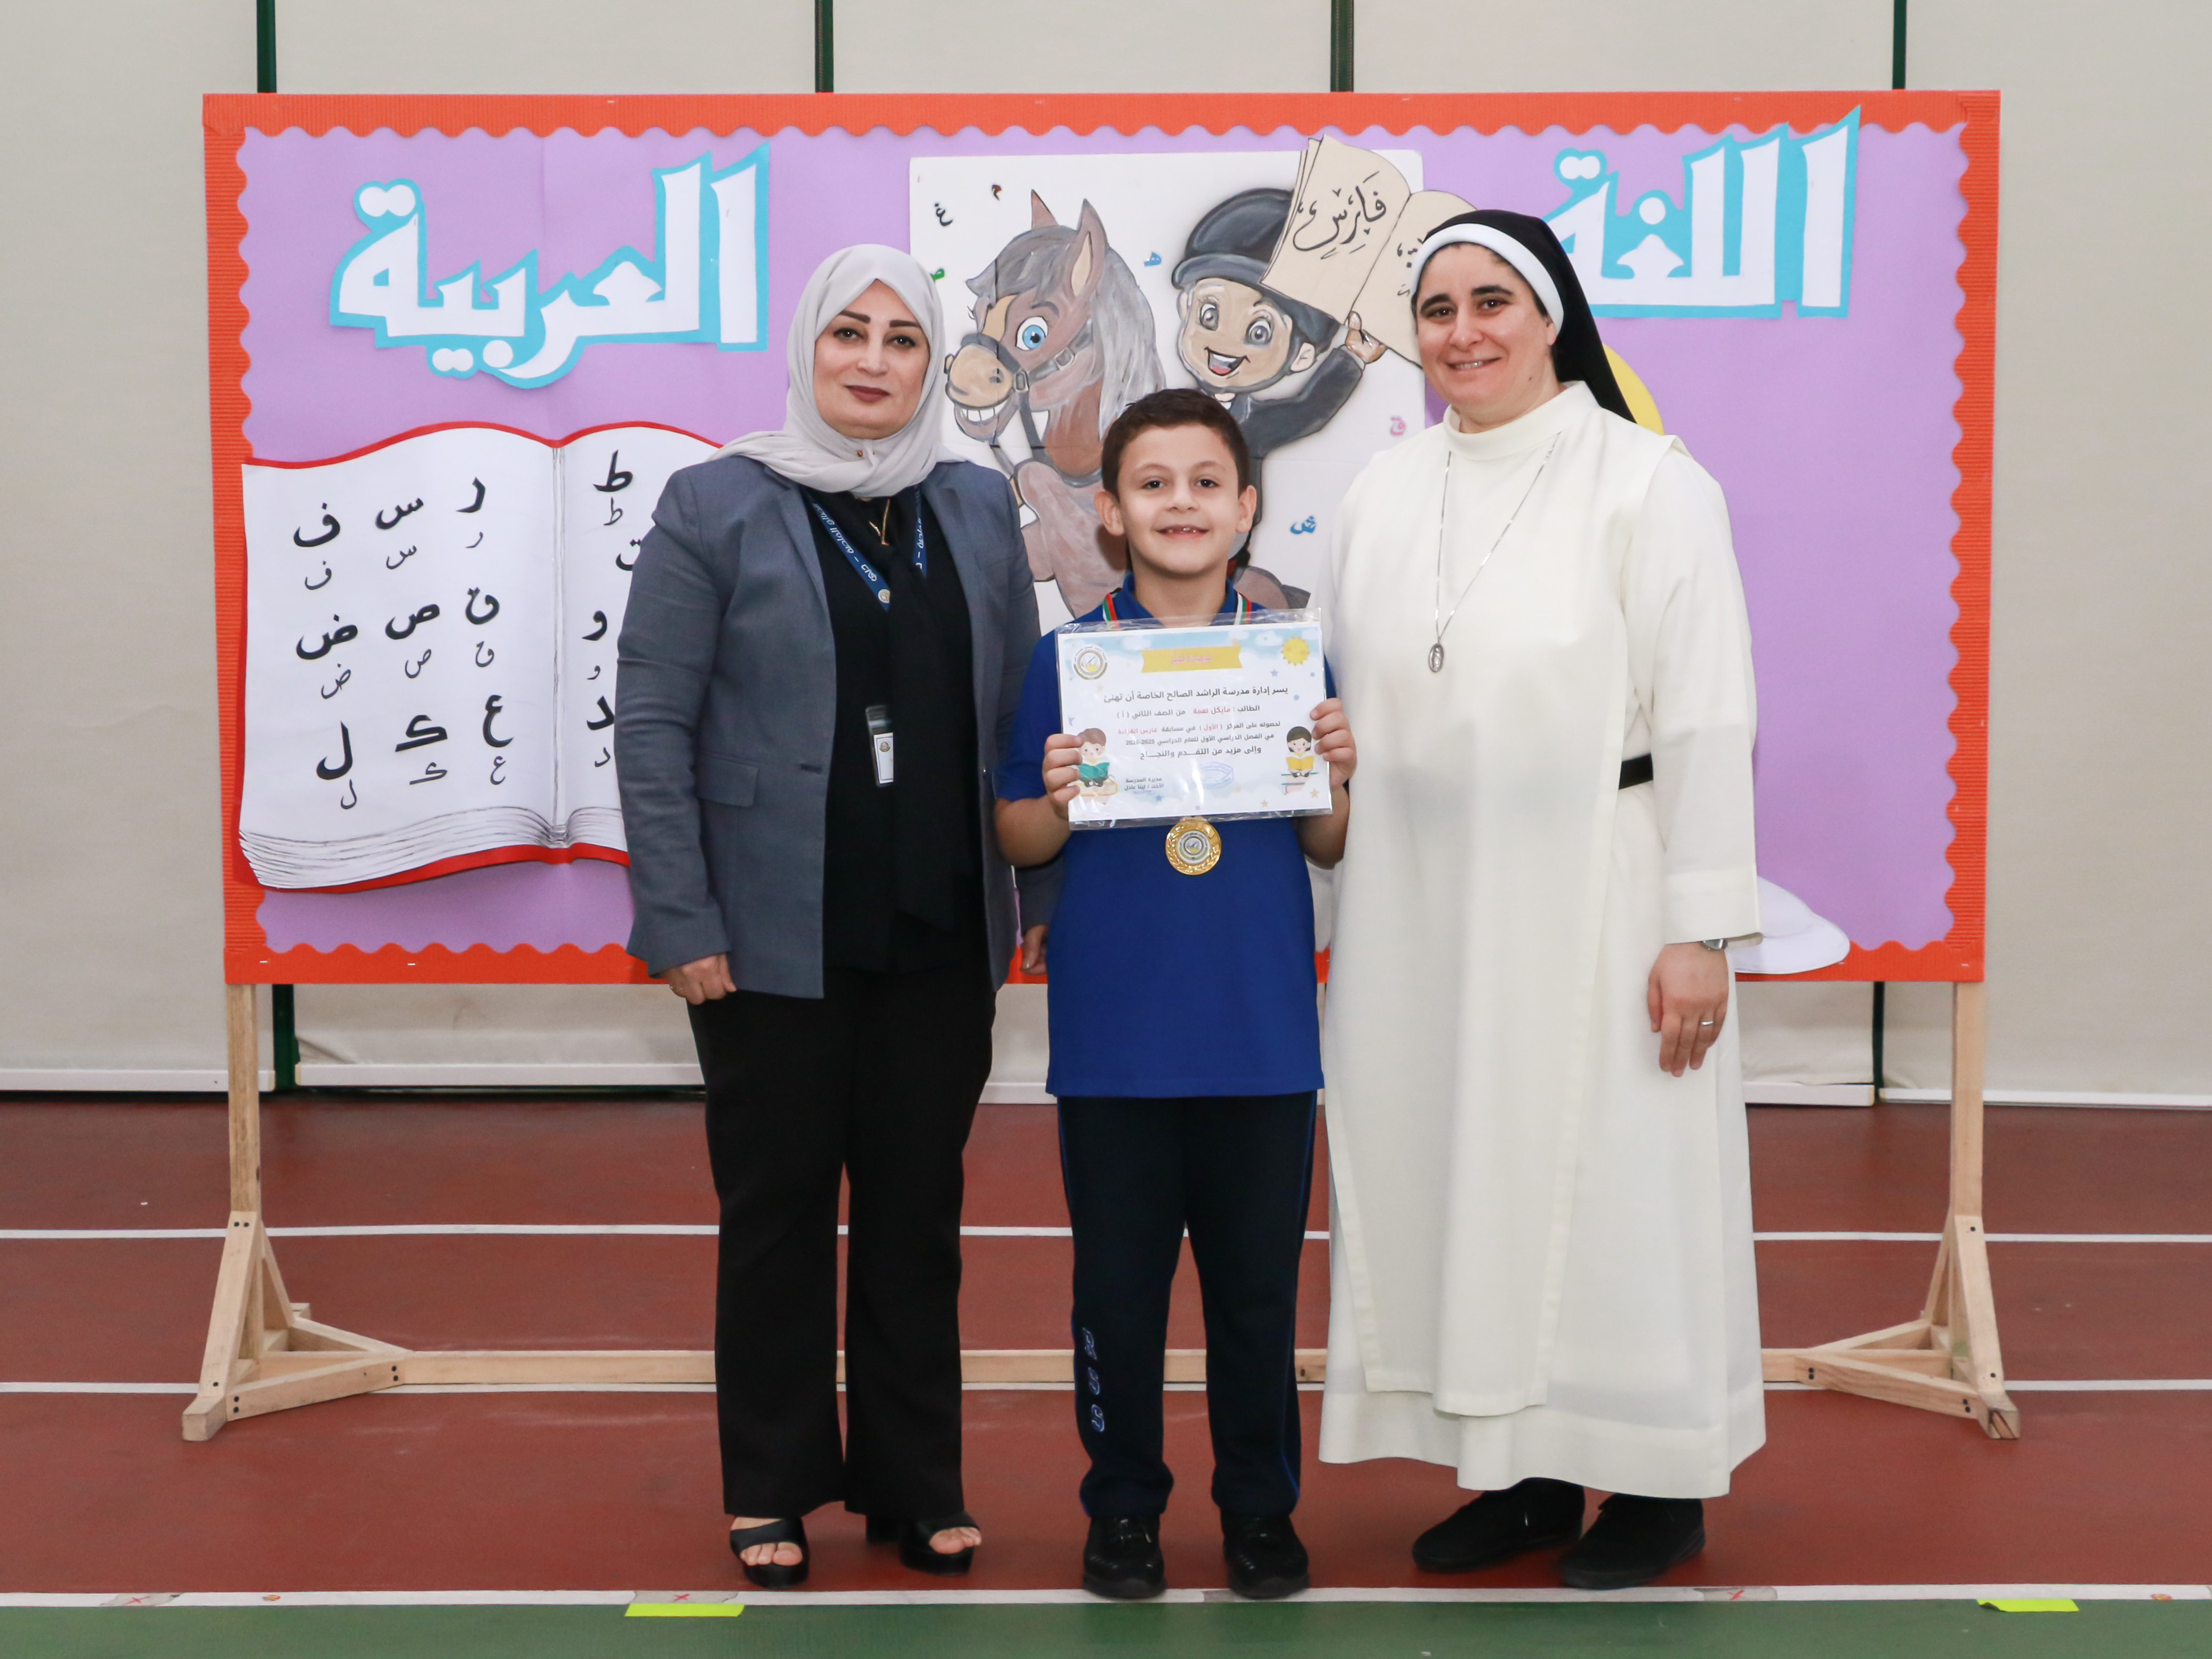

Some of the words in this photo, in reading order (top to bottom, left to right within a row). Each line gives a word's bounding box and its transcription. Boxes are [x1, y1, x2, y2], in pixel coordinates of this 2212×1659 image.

[1544, 115, 1855, 313] اللغة
[333, 153, 764, 385] العربية
[593, 450, 634, 493] ط
[457, 476, 486, 513] ر
[293, 502, 341, 548] ف
[375, 497, 424, 530] س
[603, 497, 623, 526] ط
[385, 545, 417, 570] س
[304, 560, 333, 591] ف
[384, 603, 441, 641] ص
[465, 587, 500, 626] ق
[295, 613, 358, 661] ض
[581, 610, 608, 642] و
[404, 648, 432, 679] ص
[586, 665, 601, 680] و
[1125, 690, 1135, 701] أن
[1166, 689, 1193, 701] الصالح
[1196, 688, 1220, 697] الراشد
[1223, 687, 1250, 696] مدرسة
[1252, 686, 1270, 696] إدارة
[482, 694, 514, 748] ع
[586, 695, 615, 731] د
[1132, 710, 1152, 720] الثاني
[1211, 706, 1231, 715] مايكل
[394, 714, 449, 753] ك
[1157, 737, 1182, 746] الدراسي
[1217, 735, 1242, 744] الدراسي
[316, 720, 354, 781] ل
[1244, 746, 1261, 754] وإلى
[490, 755, 506, 786] ع
[340, 778, 358, 811] ل
